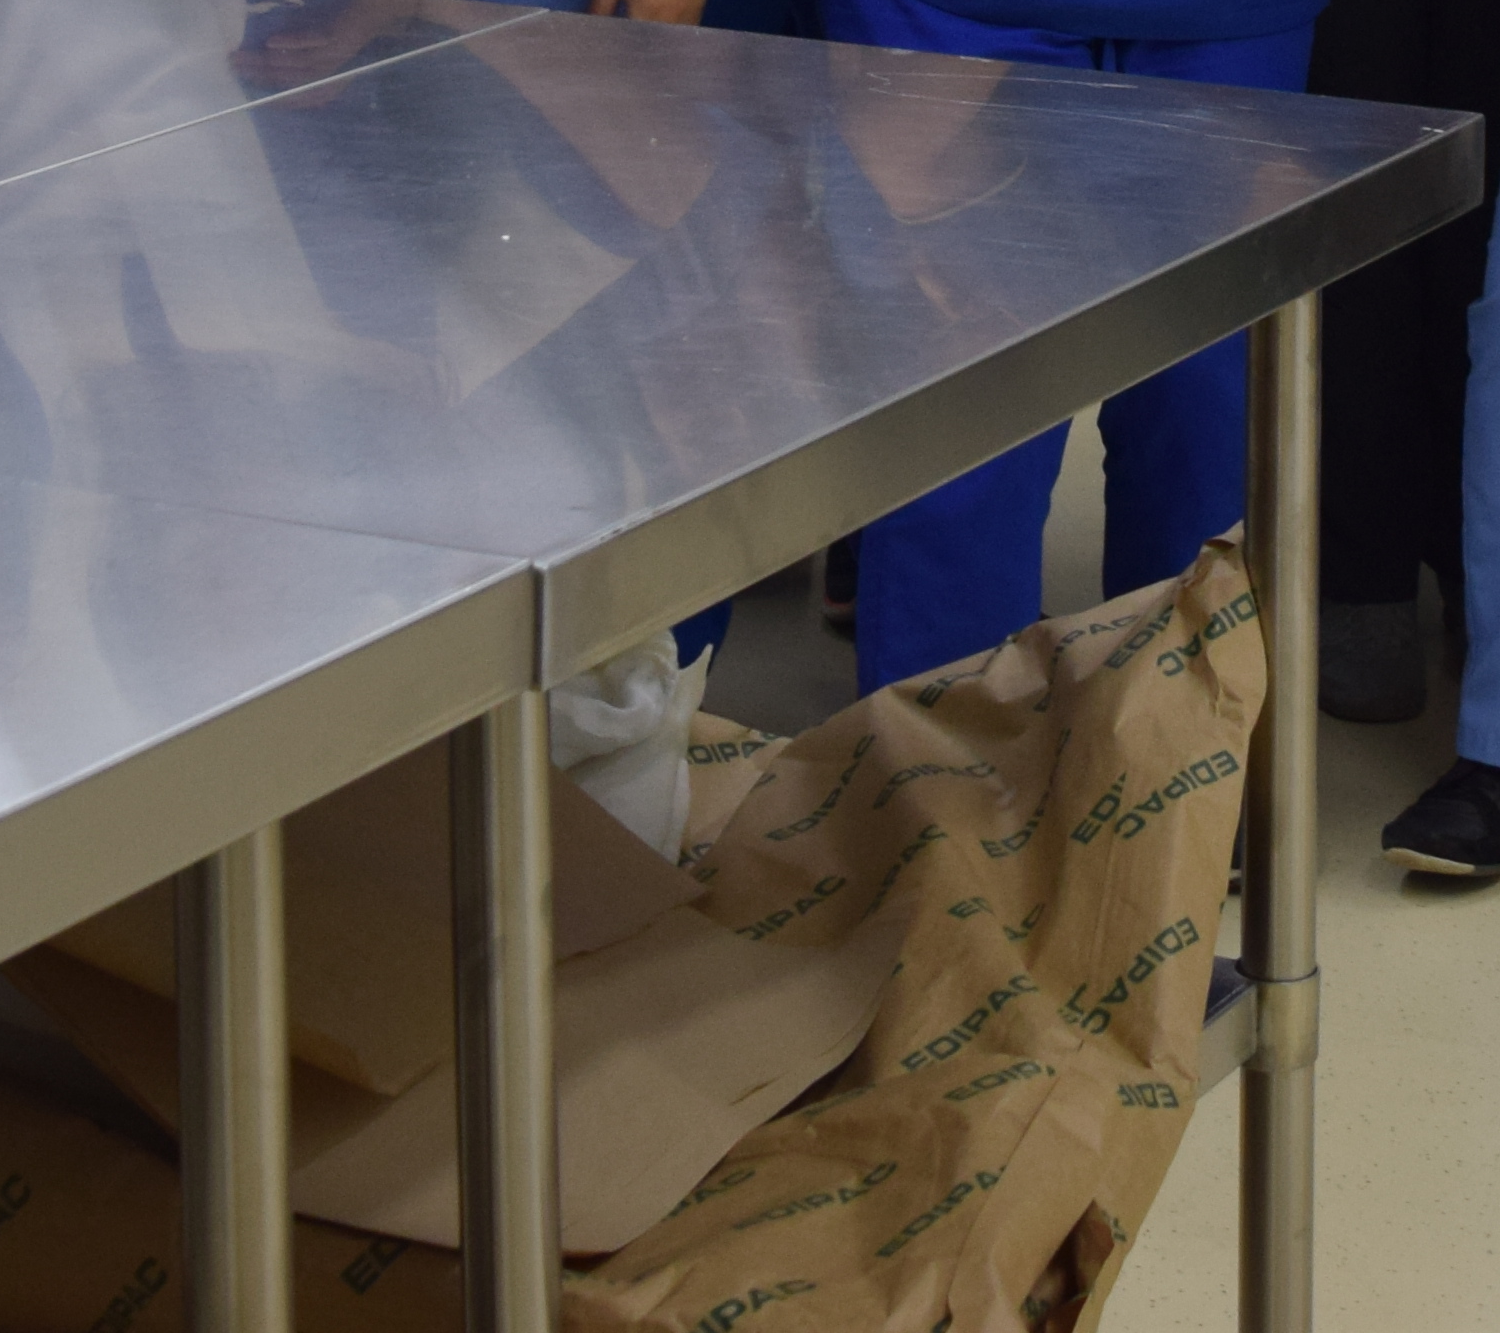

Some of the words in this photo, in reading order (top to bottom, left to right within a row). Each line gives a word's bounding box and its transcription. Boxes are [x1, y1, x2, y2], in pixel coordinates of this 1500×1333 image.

[1156, 591, 1259, 677] DIPAC
[1114, 749, 1240, 840] EDIPAC
[734, 876, 846, 941] DIPAC
[1080, 916, 1200, 1035] EDIPAC
[900, 974, 1038, 1072] EDIPAC
[732, 1161, 898, 1230] EDIPAC
